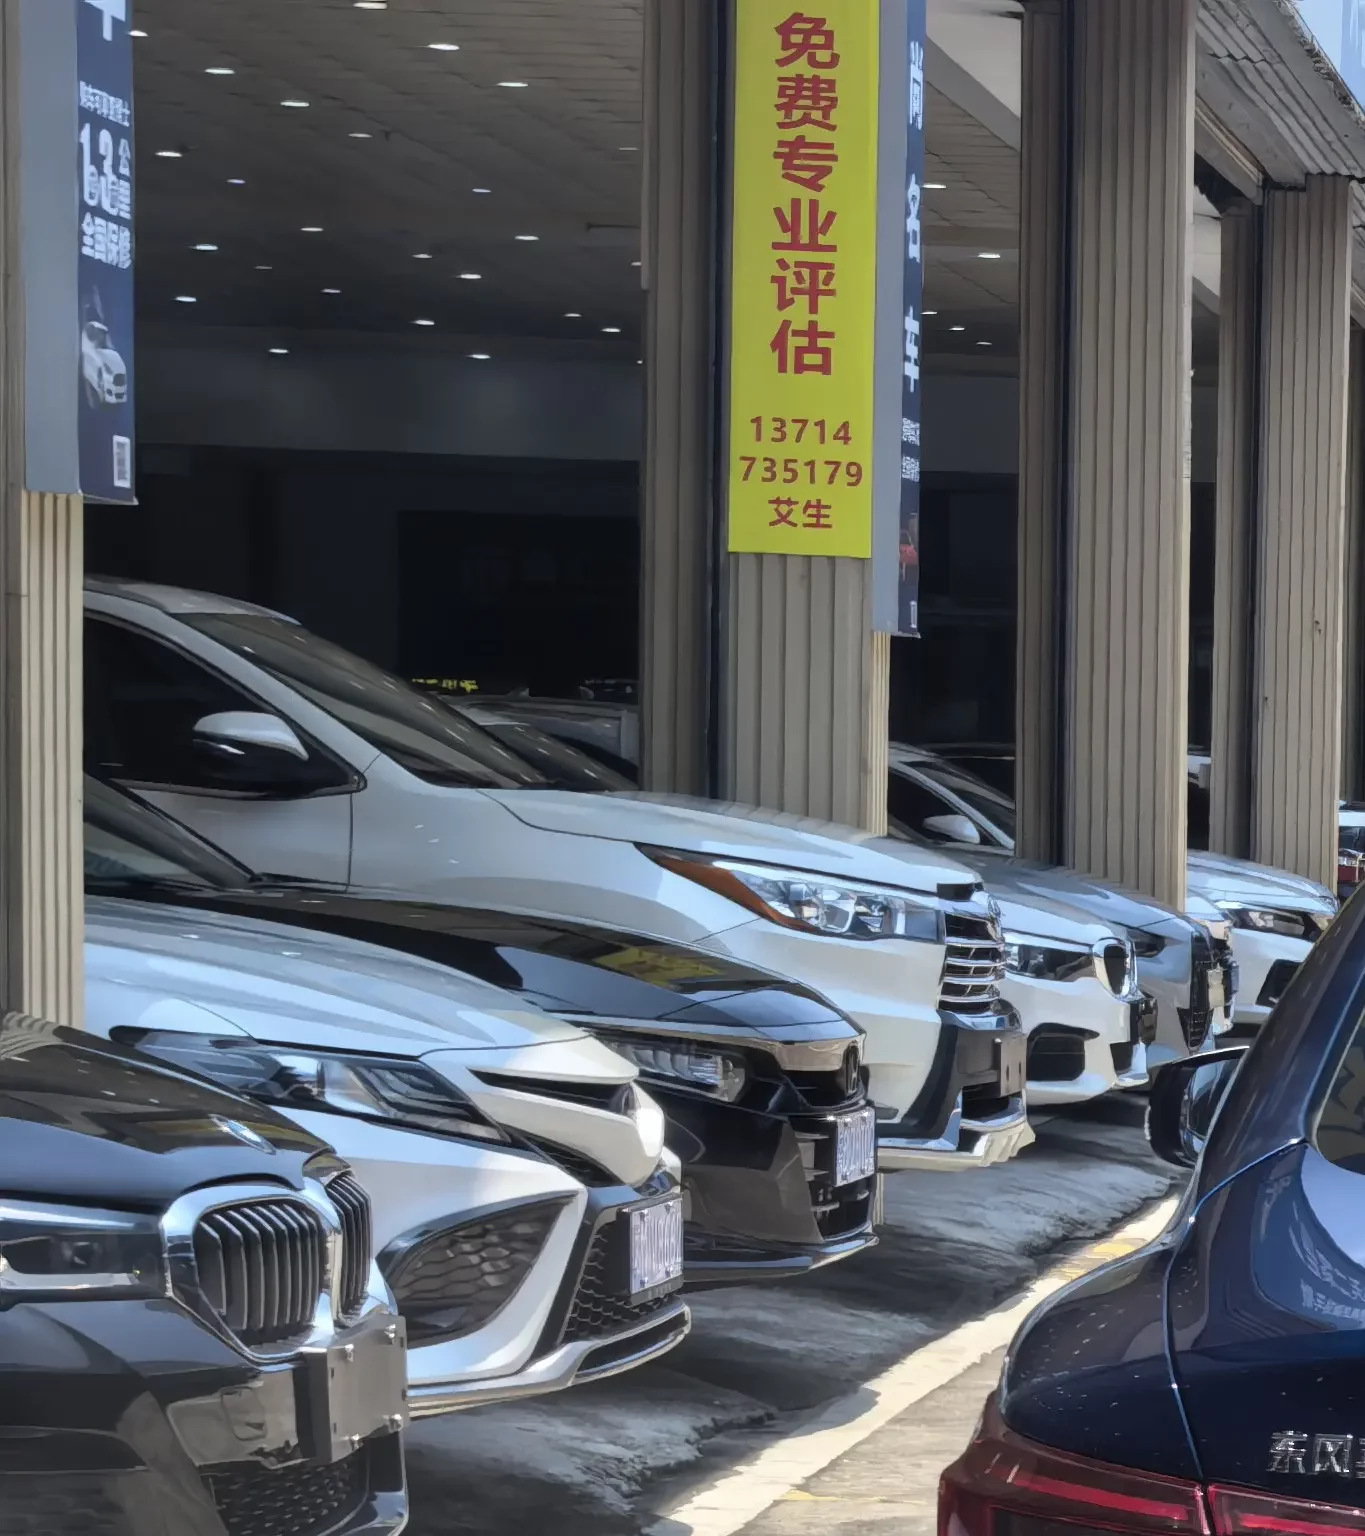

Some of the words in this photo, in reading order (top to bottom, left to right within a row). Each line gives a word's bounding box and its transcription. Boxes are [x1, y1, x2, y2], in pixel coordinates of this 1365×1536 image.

[770, 12, 840, 376] 免费专业评估
[749, 415, 853, 446] 13714
[738, 456, 864, 488] 735179
[767, 497, 834, 530] 艾生
